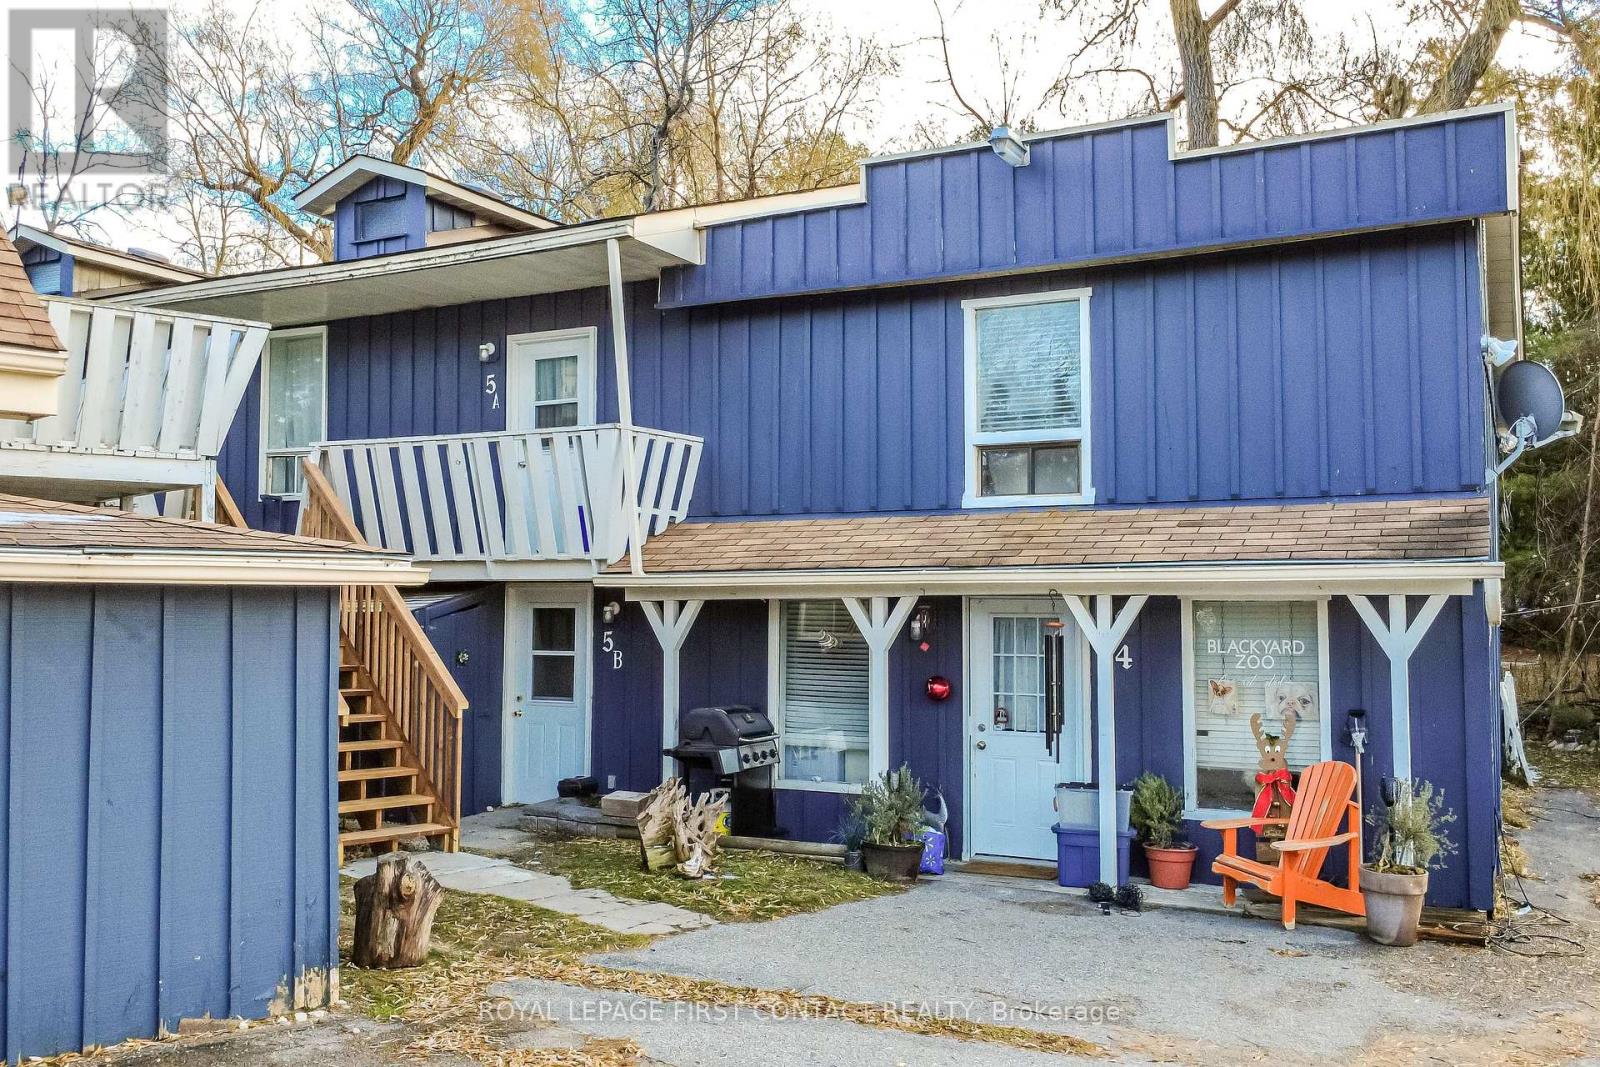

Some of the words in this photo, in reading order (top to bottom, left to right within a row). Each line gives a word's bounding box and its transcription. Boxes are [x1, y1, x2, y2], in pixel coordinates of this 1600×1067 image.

[1207, 639, 1305, 654] BLACKYARD
[1115, 644, 1133, 670] 4
[1235, 655, 1275, 669] ZOO
